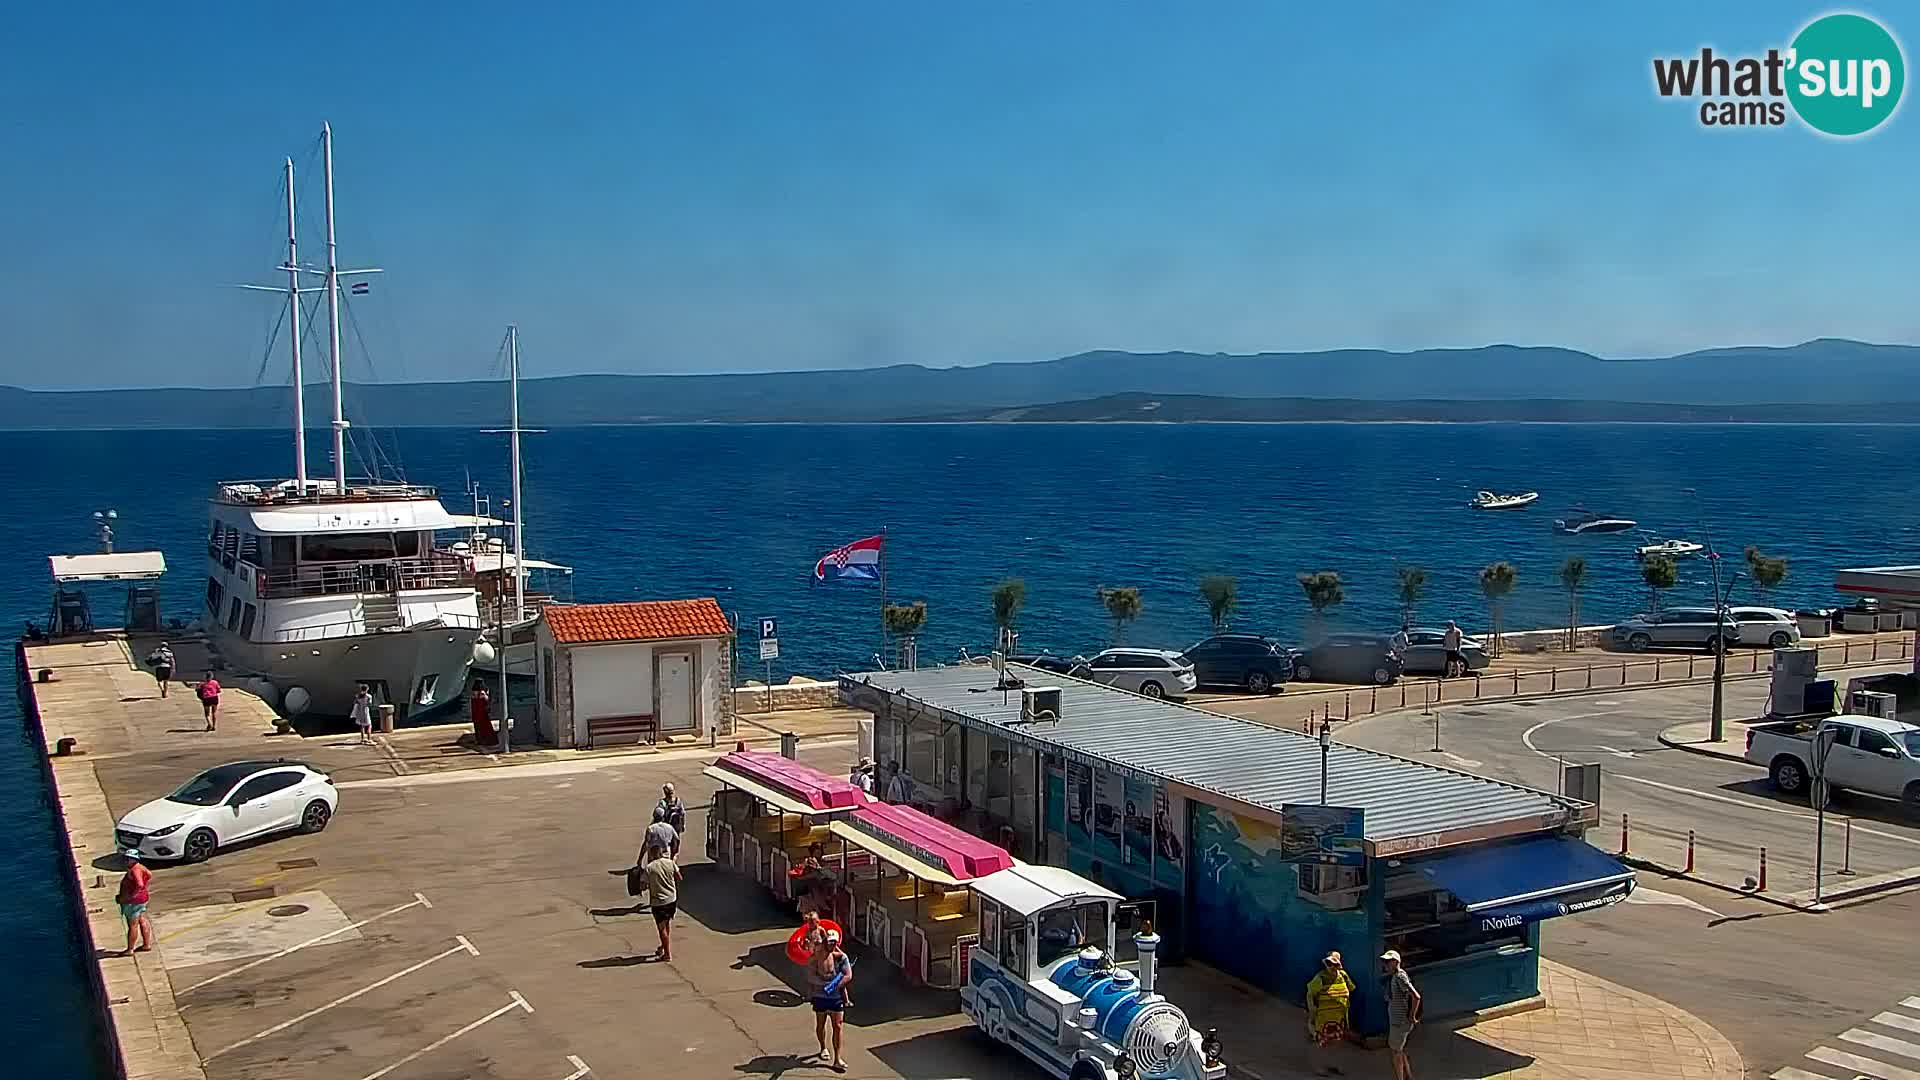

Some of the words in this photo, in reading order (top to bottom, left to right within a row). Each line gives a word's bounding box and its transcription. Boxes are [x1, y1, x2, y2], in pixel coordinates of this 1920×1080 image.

[763, 620, 774, 637] P
[1062, 749, 1075, 762] BUS
[1076, 753, 1107, 770] STATION
[1110, 763, 1133, 778] TICKET
[1135, 771, 1161, 786] OFFICE
